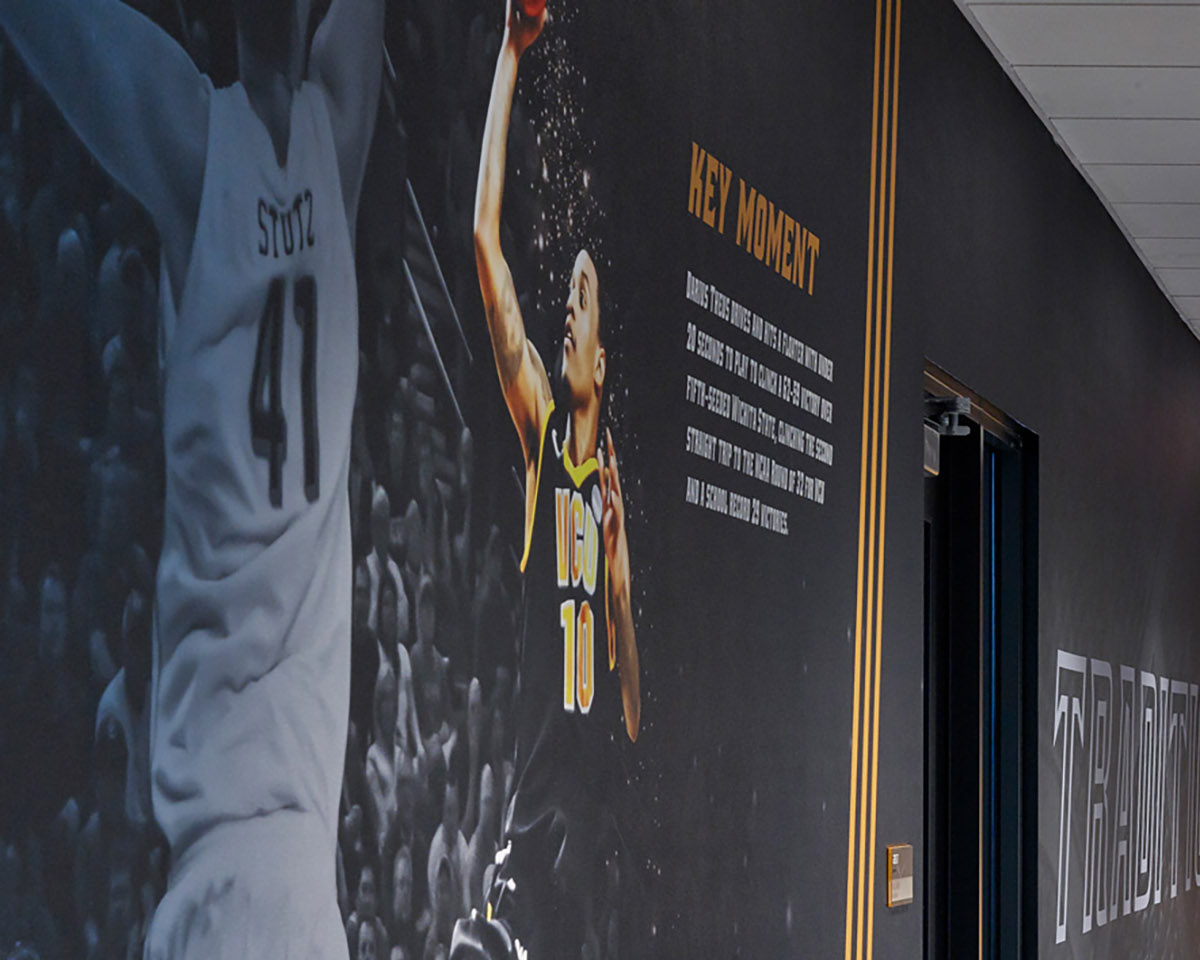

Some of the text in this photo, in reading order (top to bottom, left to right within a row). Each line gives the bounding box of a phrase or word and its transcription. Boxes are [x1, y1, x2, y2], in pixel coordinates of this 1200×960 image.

[258, 189, 314, 258] STUTZ
[688, 141, 820, 296] KEY MOMENT
[250, 273, 320, 510] 41
[555, 488, 599, 596] VCU
[560, 599, 594, 714] 10
